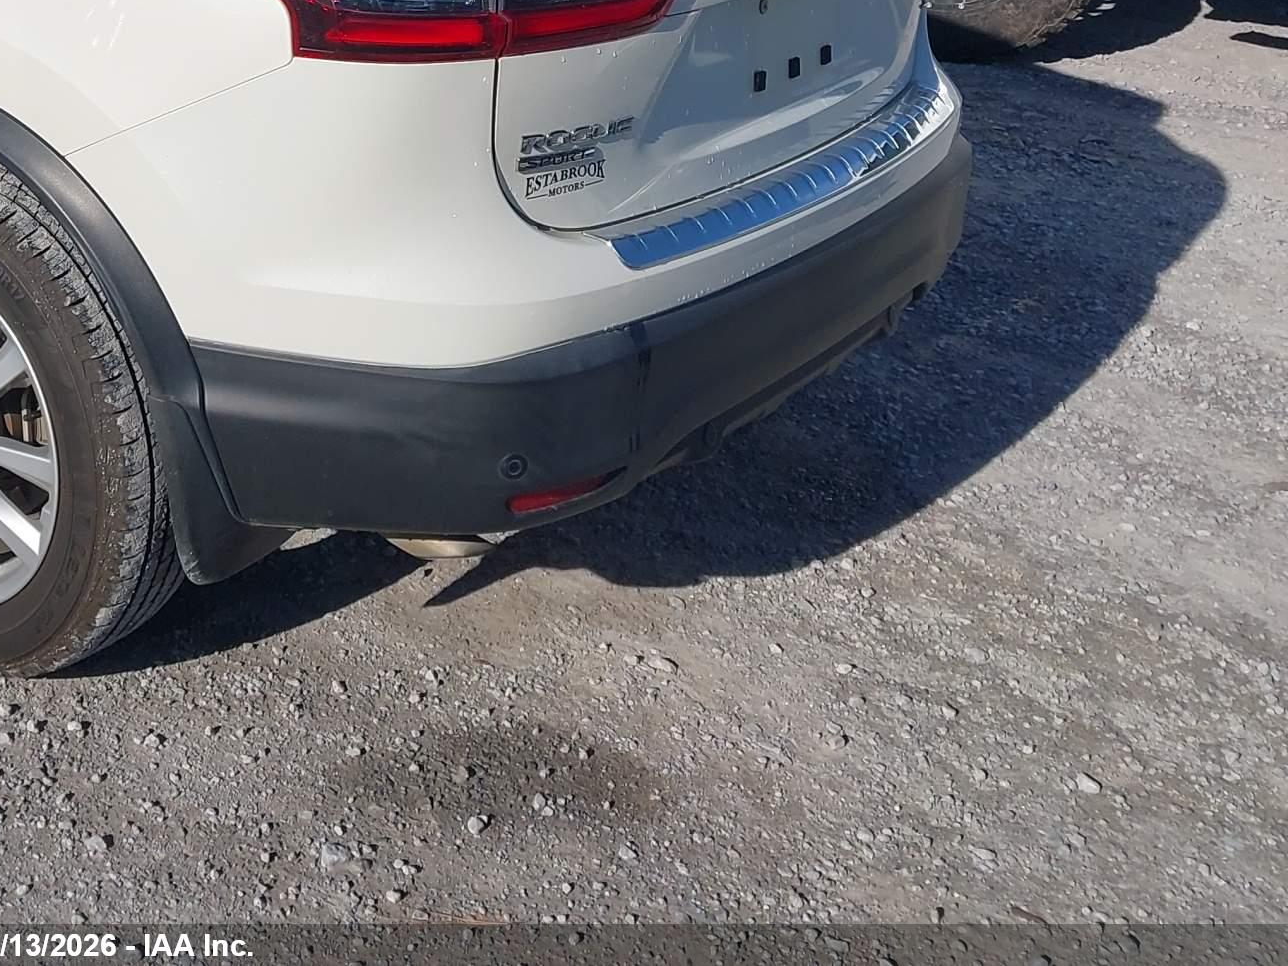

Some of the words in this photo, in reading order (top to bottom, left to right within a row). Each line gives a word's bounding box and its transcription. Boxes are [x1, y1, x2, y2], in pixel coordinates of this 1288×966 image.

[520, 116, 634, 154] ROGUE
[523, 146, 596, 170] SPORT
[525, 159, 606, 197] ESTABROOK
[548, 181, 585, 197] MOTORS
